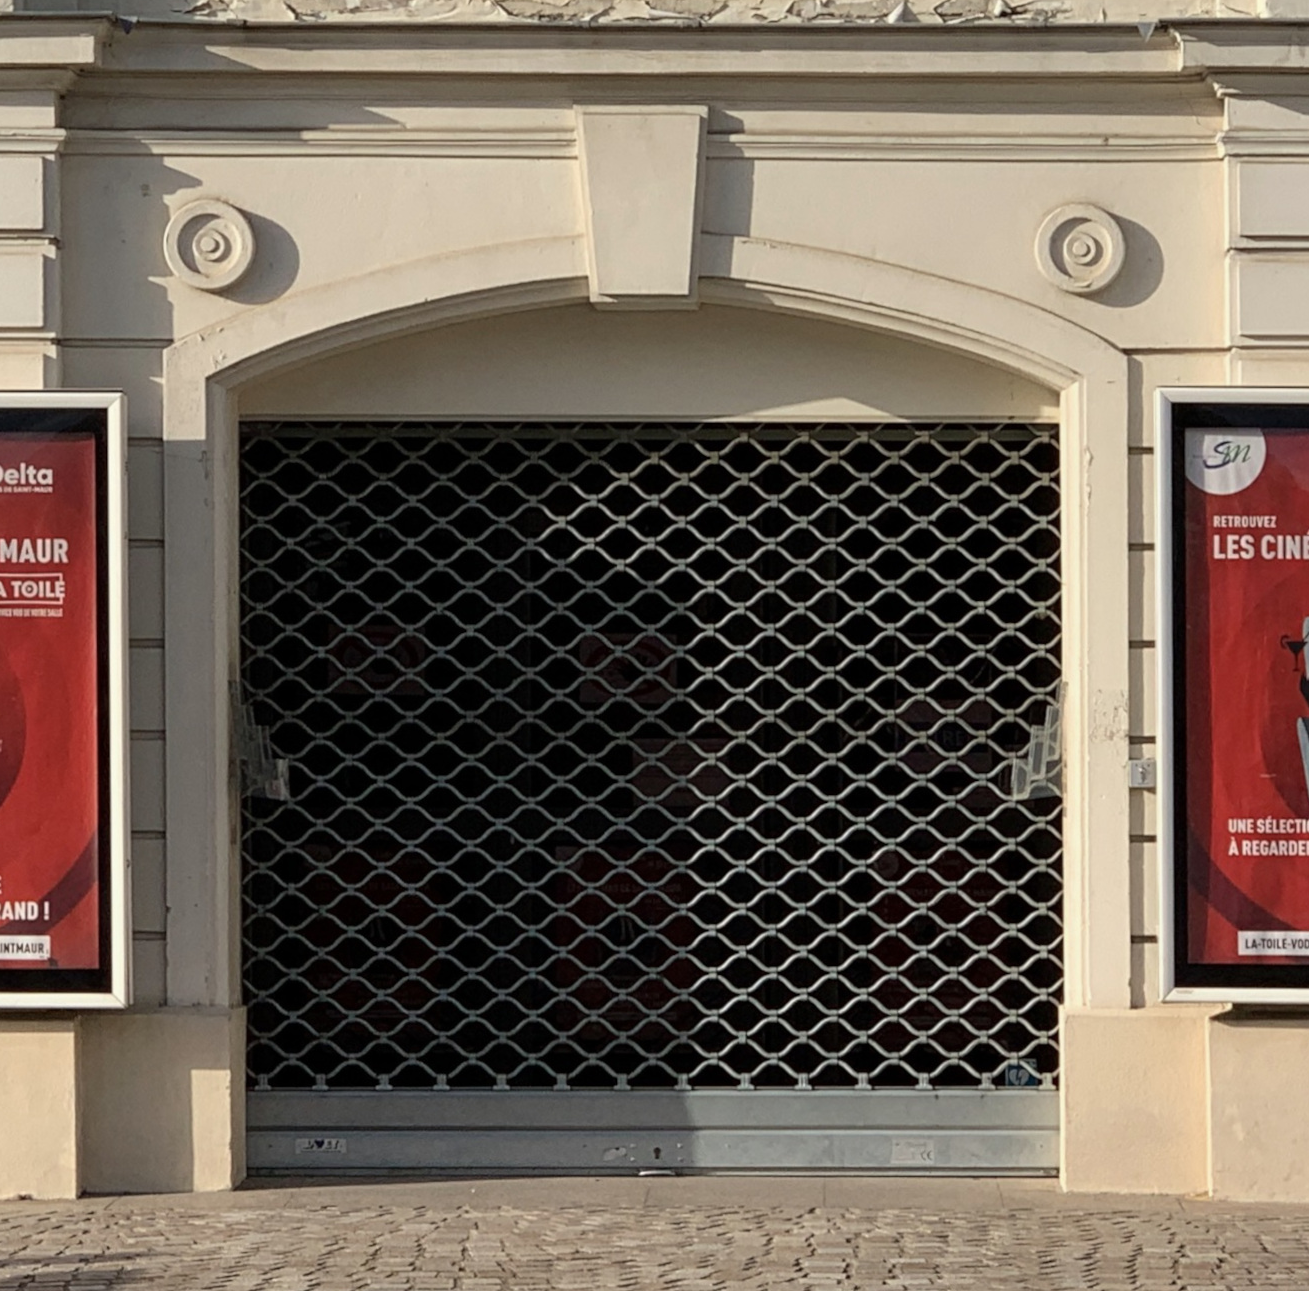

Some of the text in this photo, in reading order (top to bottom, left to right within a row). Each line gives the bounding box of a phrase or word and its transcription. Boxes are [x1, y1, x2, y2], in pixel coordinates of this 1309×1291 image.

[1213, 515, 1277, 528] RETROUVEZ
[1213, 534, 1254, 560] LES
[11, 581, 65, 597] TOILE
[1228, 819, 1254, 833] UNE
[1228, 837, 1239, 856] À
[43, 902, 50, 920] !
